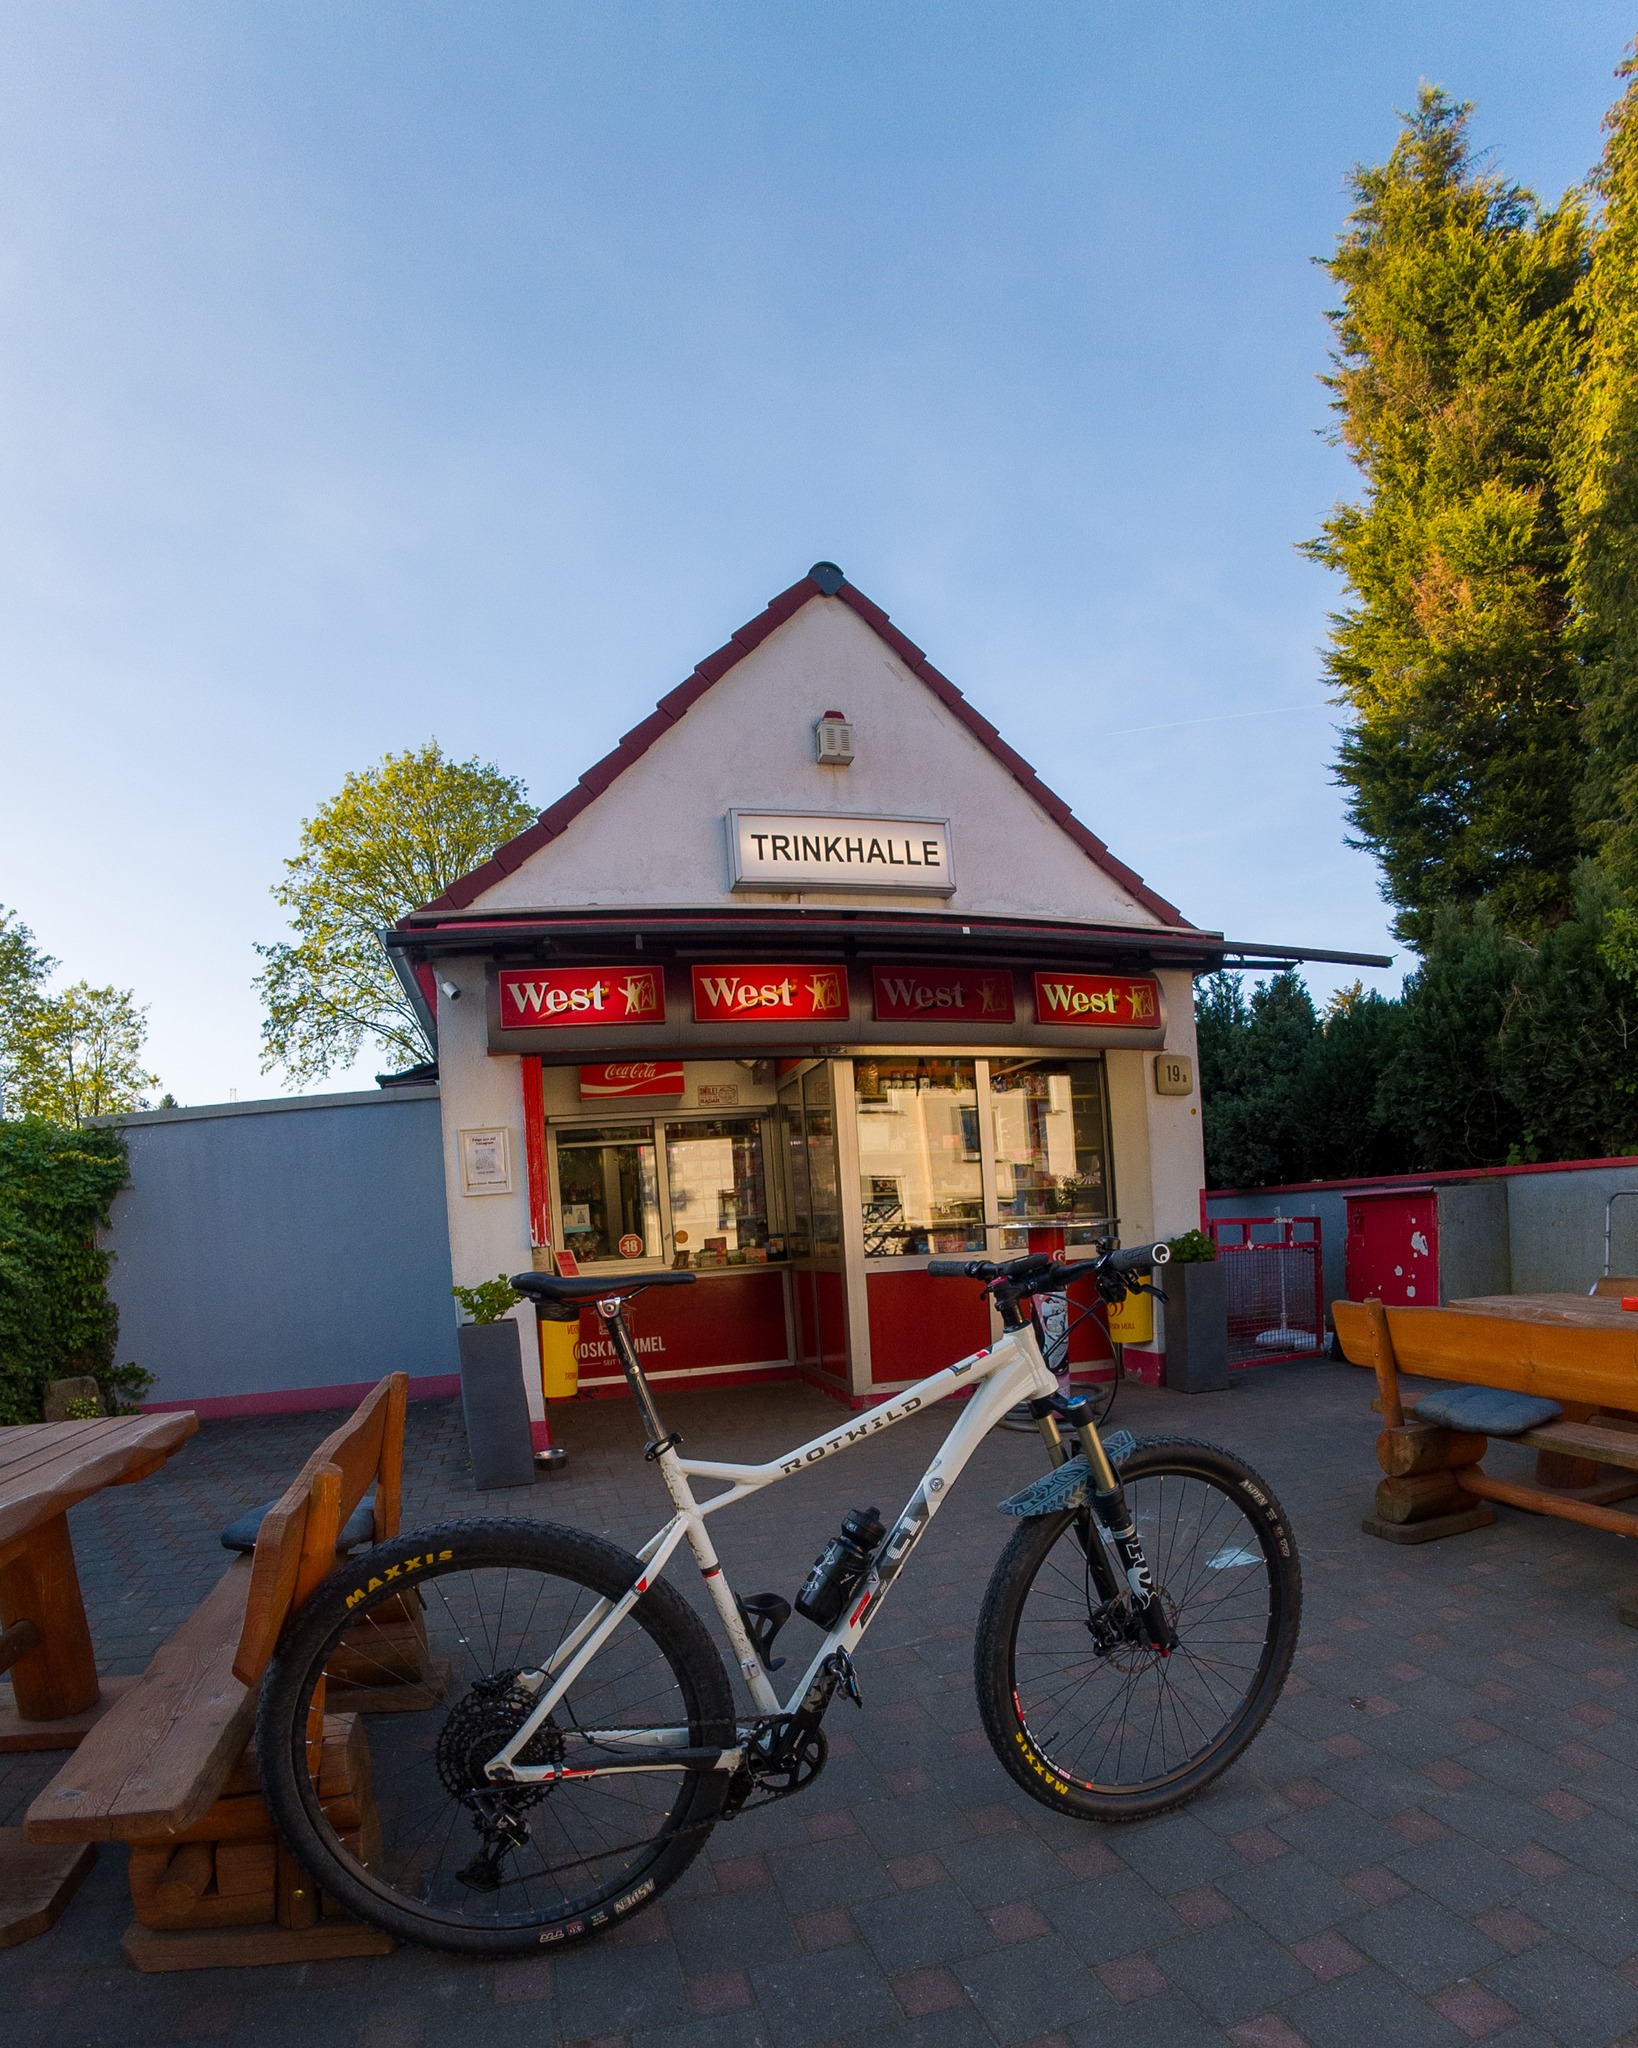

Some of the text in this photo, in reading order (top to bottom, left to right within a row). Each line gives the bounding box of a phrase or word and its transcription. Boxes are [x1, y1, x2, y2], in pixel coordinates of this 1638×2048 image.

[751, 834, 941, 867] TRINKHALLE
[507, 980, 606, 1014] West
[700, 977, 795, 1008] West
[880, 978, 965, 1009] West
[1041, 983, 1118, 1014] West
[604, 1062, 657, 1081] Coca-Cola
[779, 1396, 922, 1475] ROTWILD
[345, 1549, 454, 1609] MAXXIS
[1015, 1731, 1069, 1795] MAXXIS
[614, 1878, 656, 1915] ASPEN
